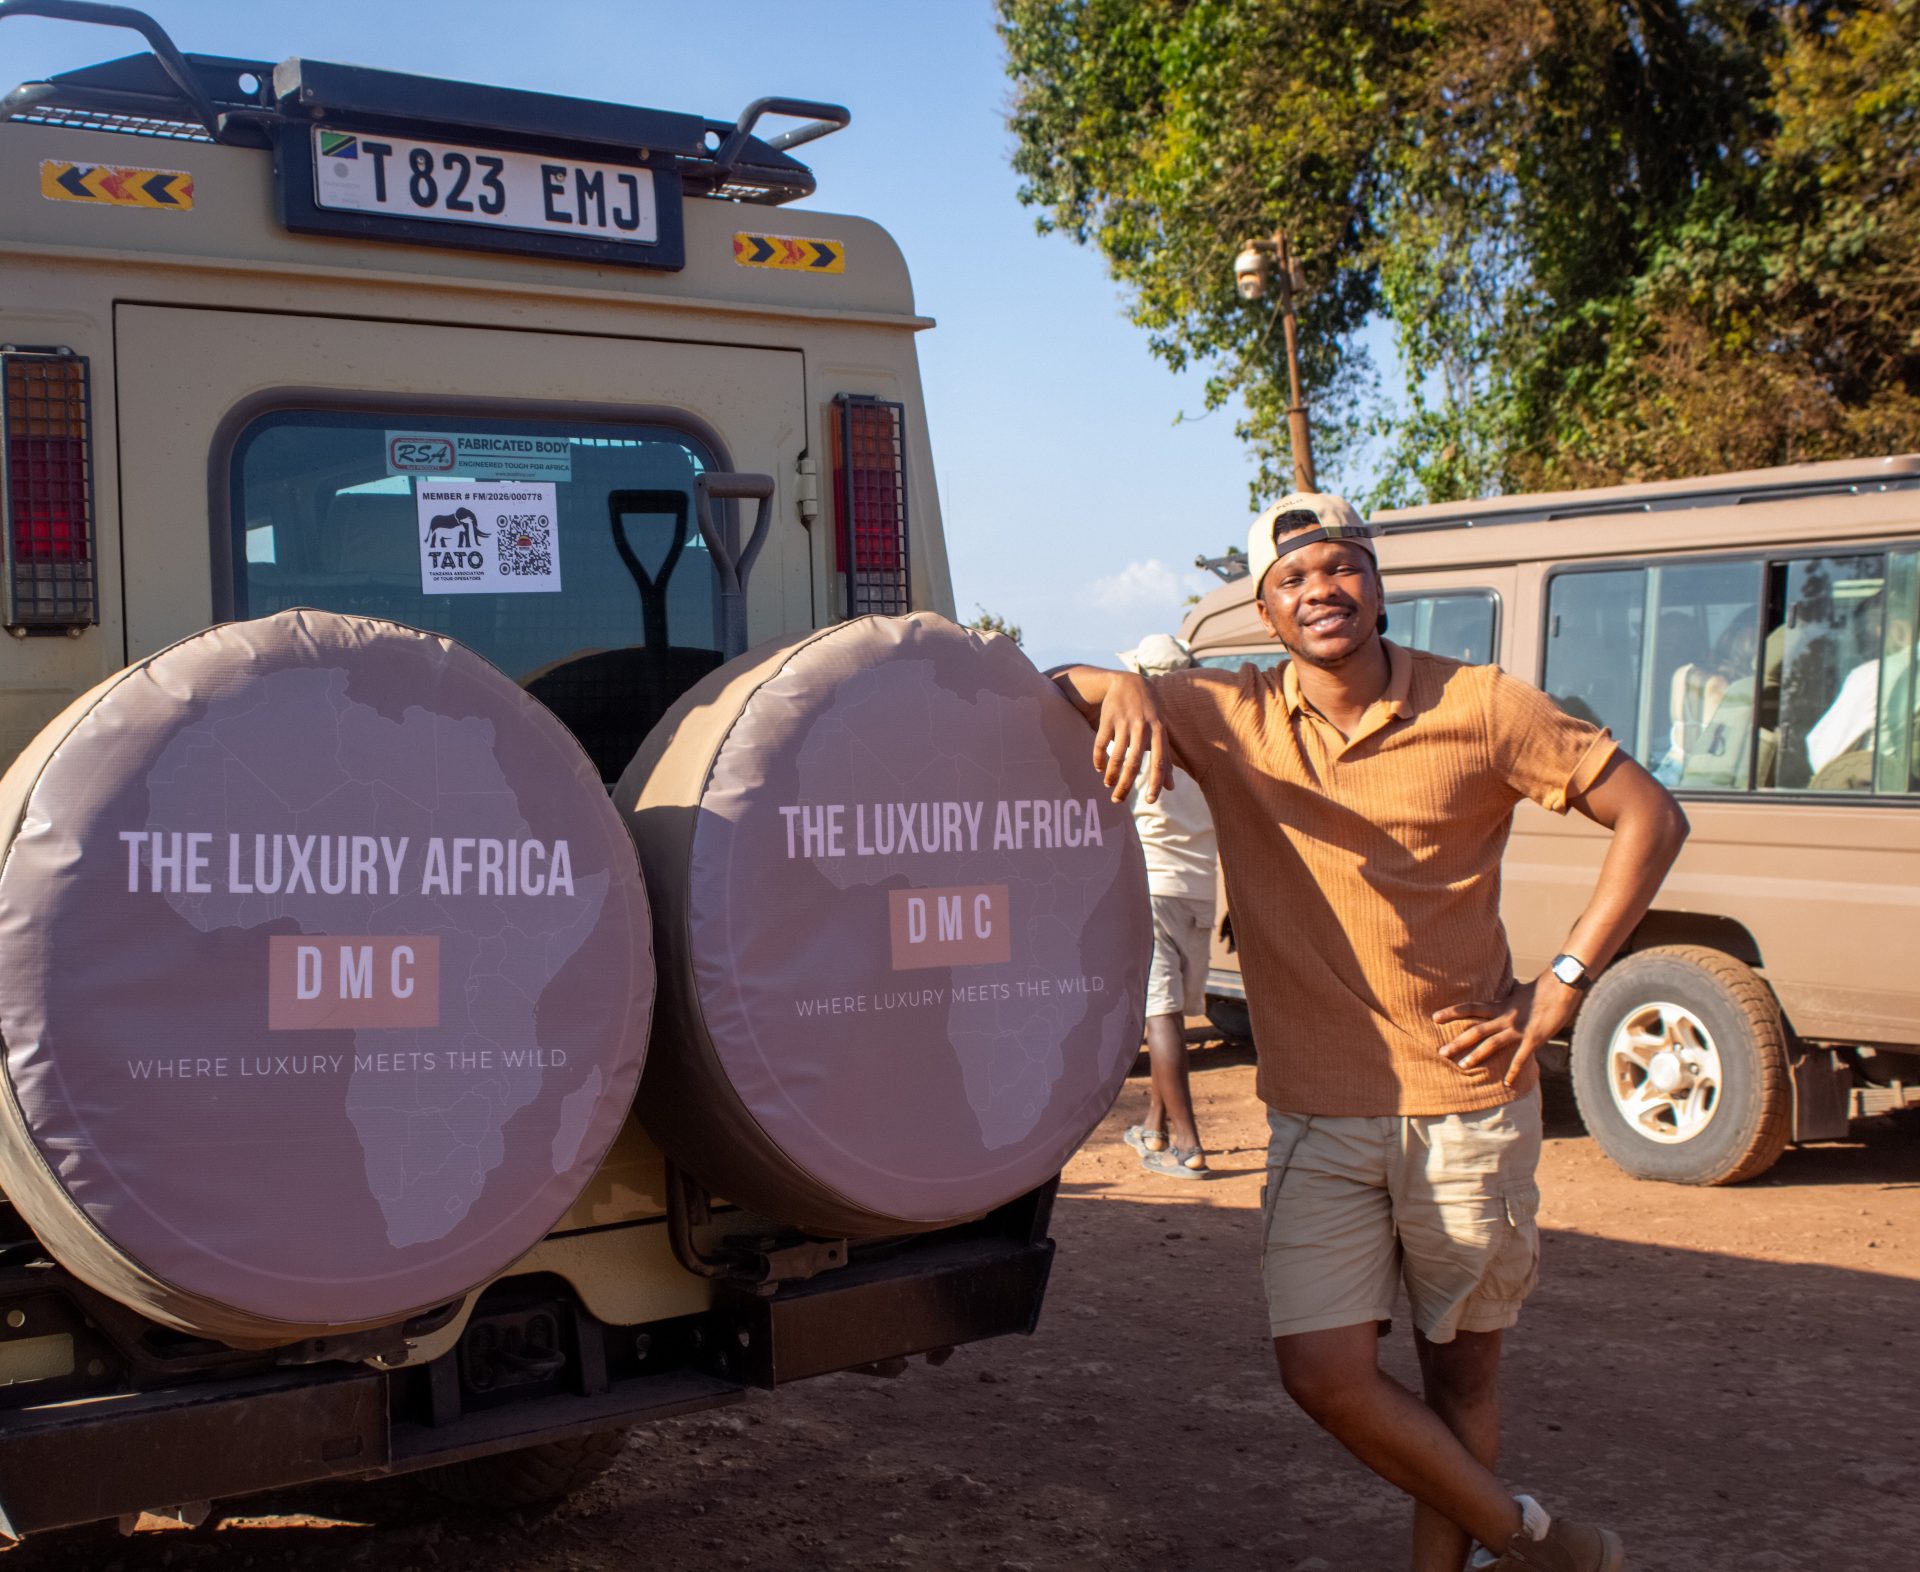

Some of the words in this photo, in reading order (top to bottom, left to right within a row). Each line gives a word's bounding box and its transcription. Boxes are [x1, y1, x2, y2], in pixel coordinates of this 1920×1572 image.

[362, 141, 393, 203] T
[408, 147, 506, 215] 823
[540, 163, 640, 231] EMJ
[398, 444, 448, 464] RSA
[457, 437, 533, 452] FABRICATED
[535, 441, 569, 454] BODY
[458, 460, 503, 469] ENGINEERED
[504, 462, 529, 470] TOUGH
[529, 463, 544, 471] FOR
[545, 463, 570, 472] AFRICA
[422, 492, 462, 501] MEMBER
[464, 492, 470, 500] #
[428, 550, 484, 570] TATO
[778, 804, 846, 859] THE
[856, 801, 984, 856] LUXURY
[993, 798, 1104, 851] AFRICA
[119, 831, 213, 894] THE
[228, 832, 410, 896] LUXURY
[420, 837, 575, 897] AFRICA
[794, 994, 867, 1017] WHERE
[874, 989, 945, 1011] LUXURY
[951, 983, 1010, 1004] MEETS
[1015, 979, 1051, 998] THE
[1056, 975, 1105, 995] WILD
[127, 1057, 230, 1080] WHERE
[240, 1054, 345, 1077] LUXURY
[353, 1052, 437, 1074] MEETS
[445, 1050, 493, 1070] THE
[502, 1048, 568, 1068] WILD
